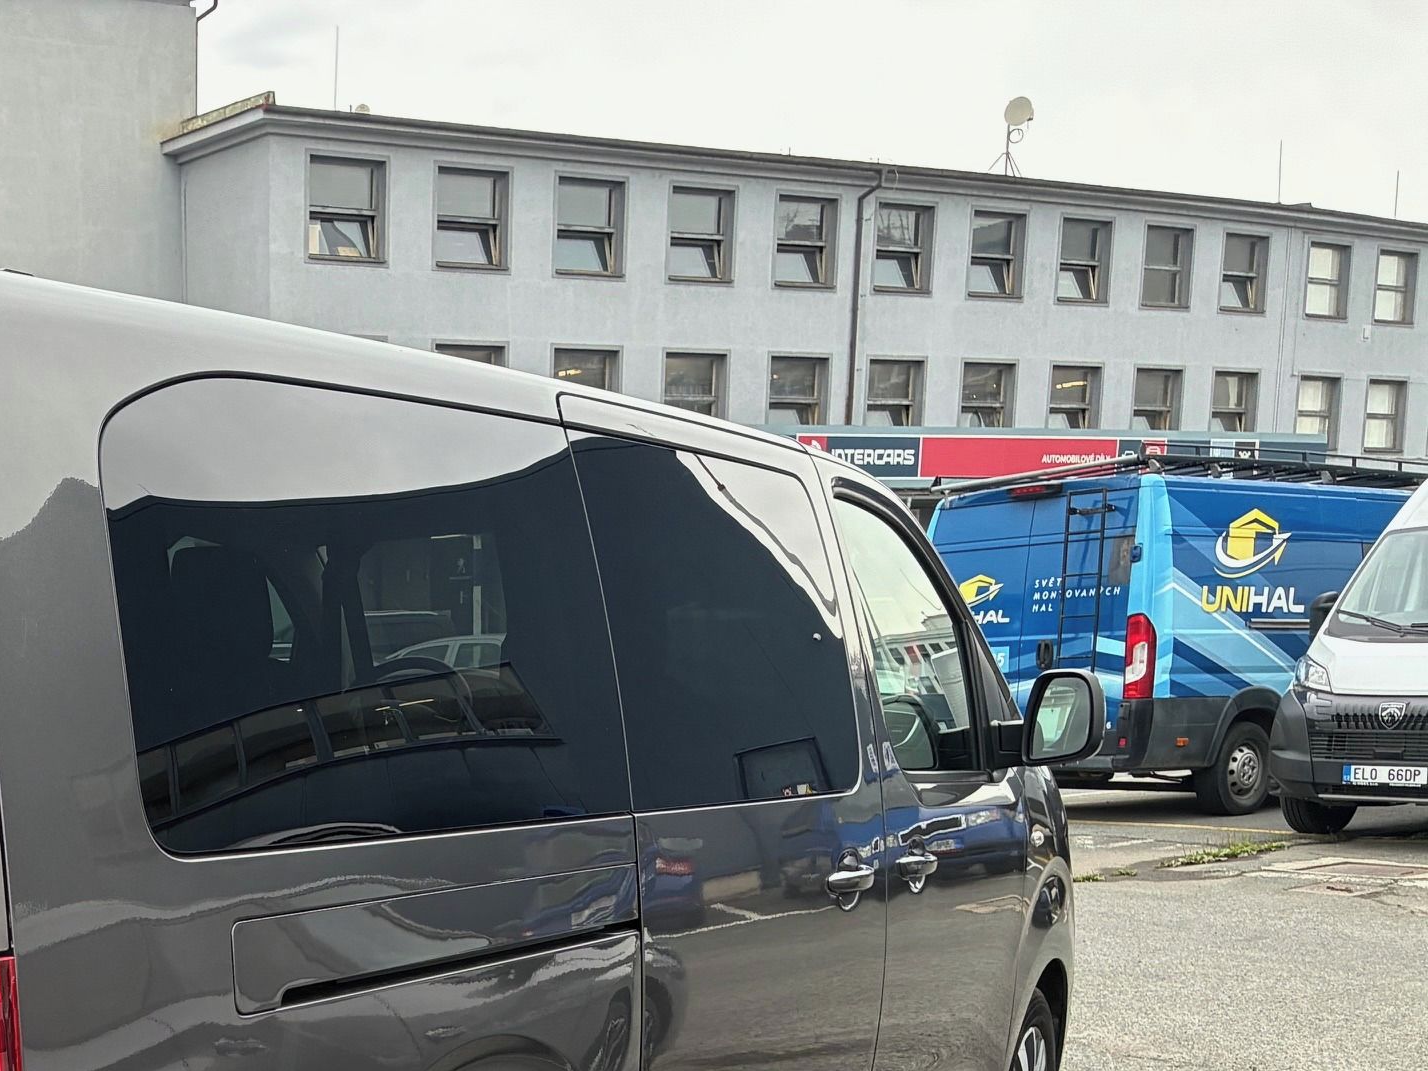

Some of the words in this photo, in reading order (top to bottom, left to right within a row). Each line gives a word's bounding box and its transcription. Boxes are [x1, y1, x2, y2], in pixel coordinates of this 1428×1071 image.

[1034, 576, 1063, 588] SVĚT
[1033, 586, 1121, 600] MONOVANCH
[1201, 585, 1305, 613] UNIHAL
[1032, 603, 1053, 613] HAL
[1388, 768, 1421, 782] 66DP
